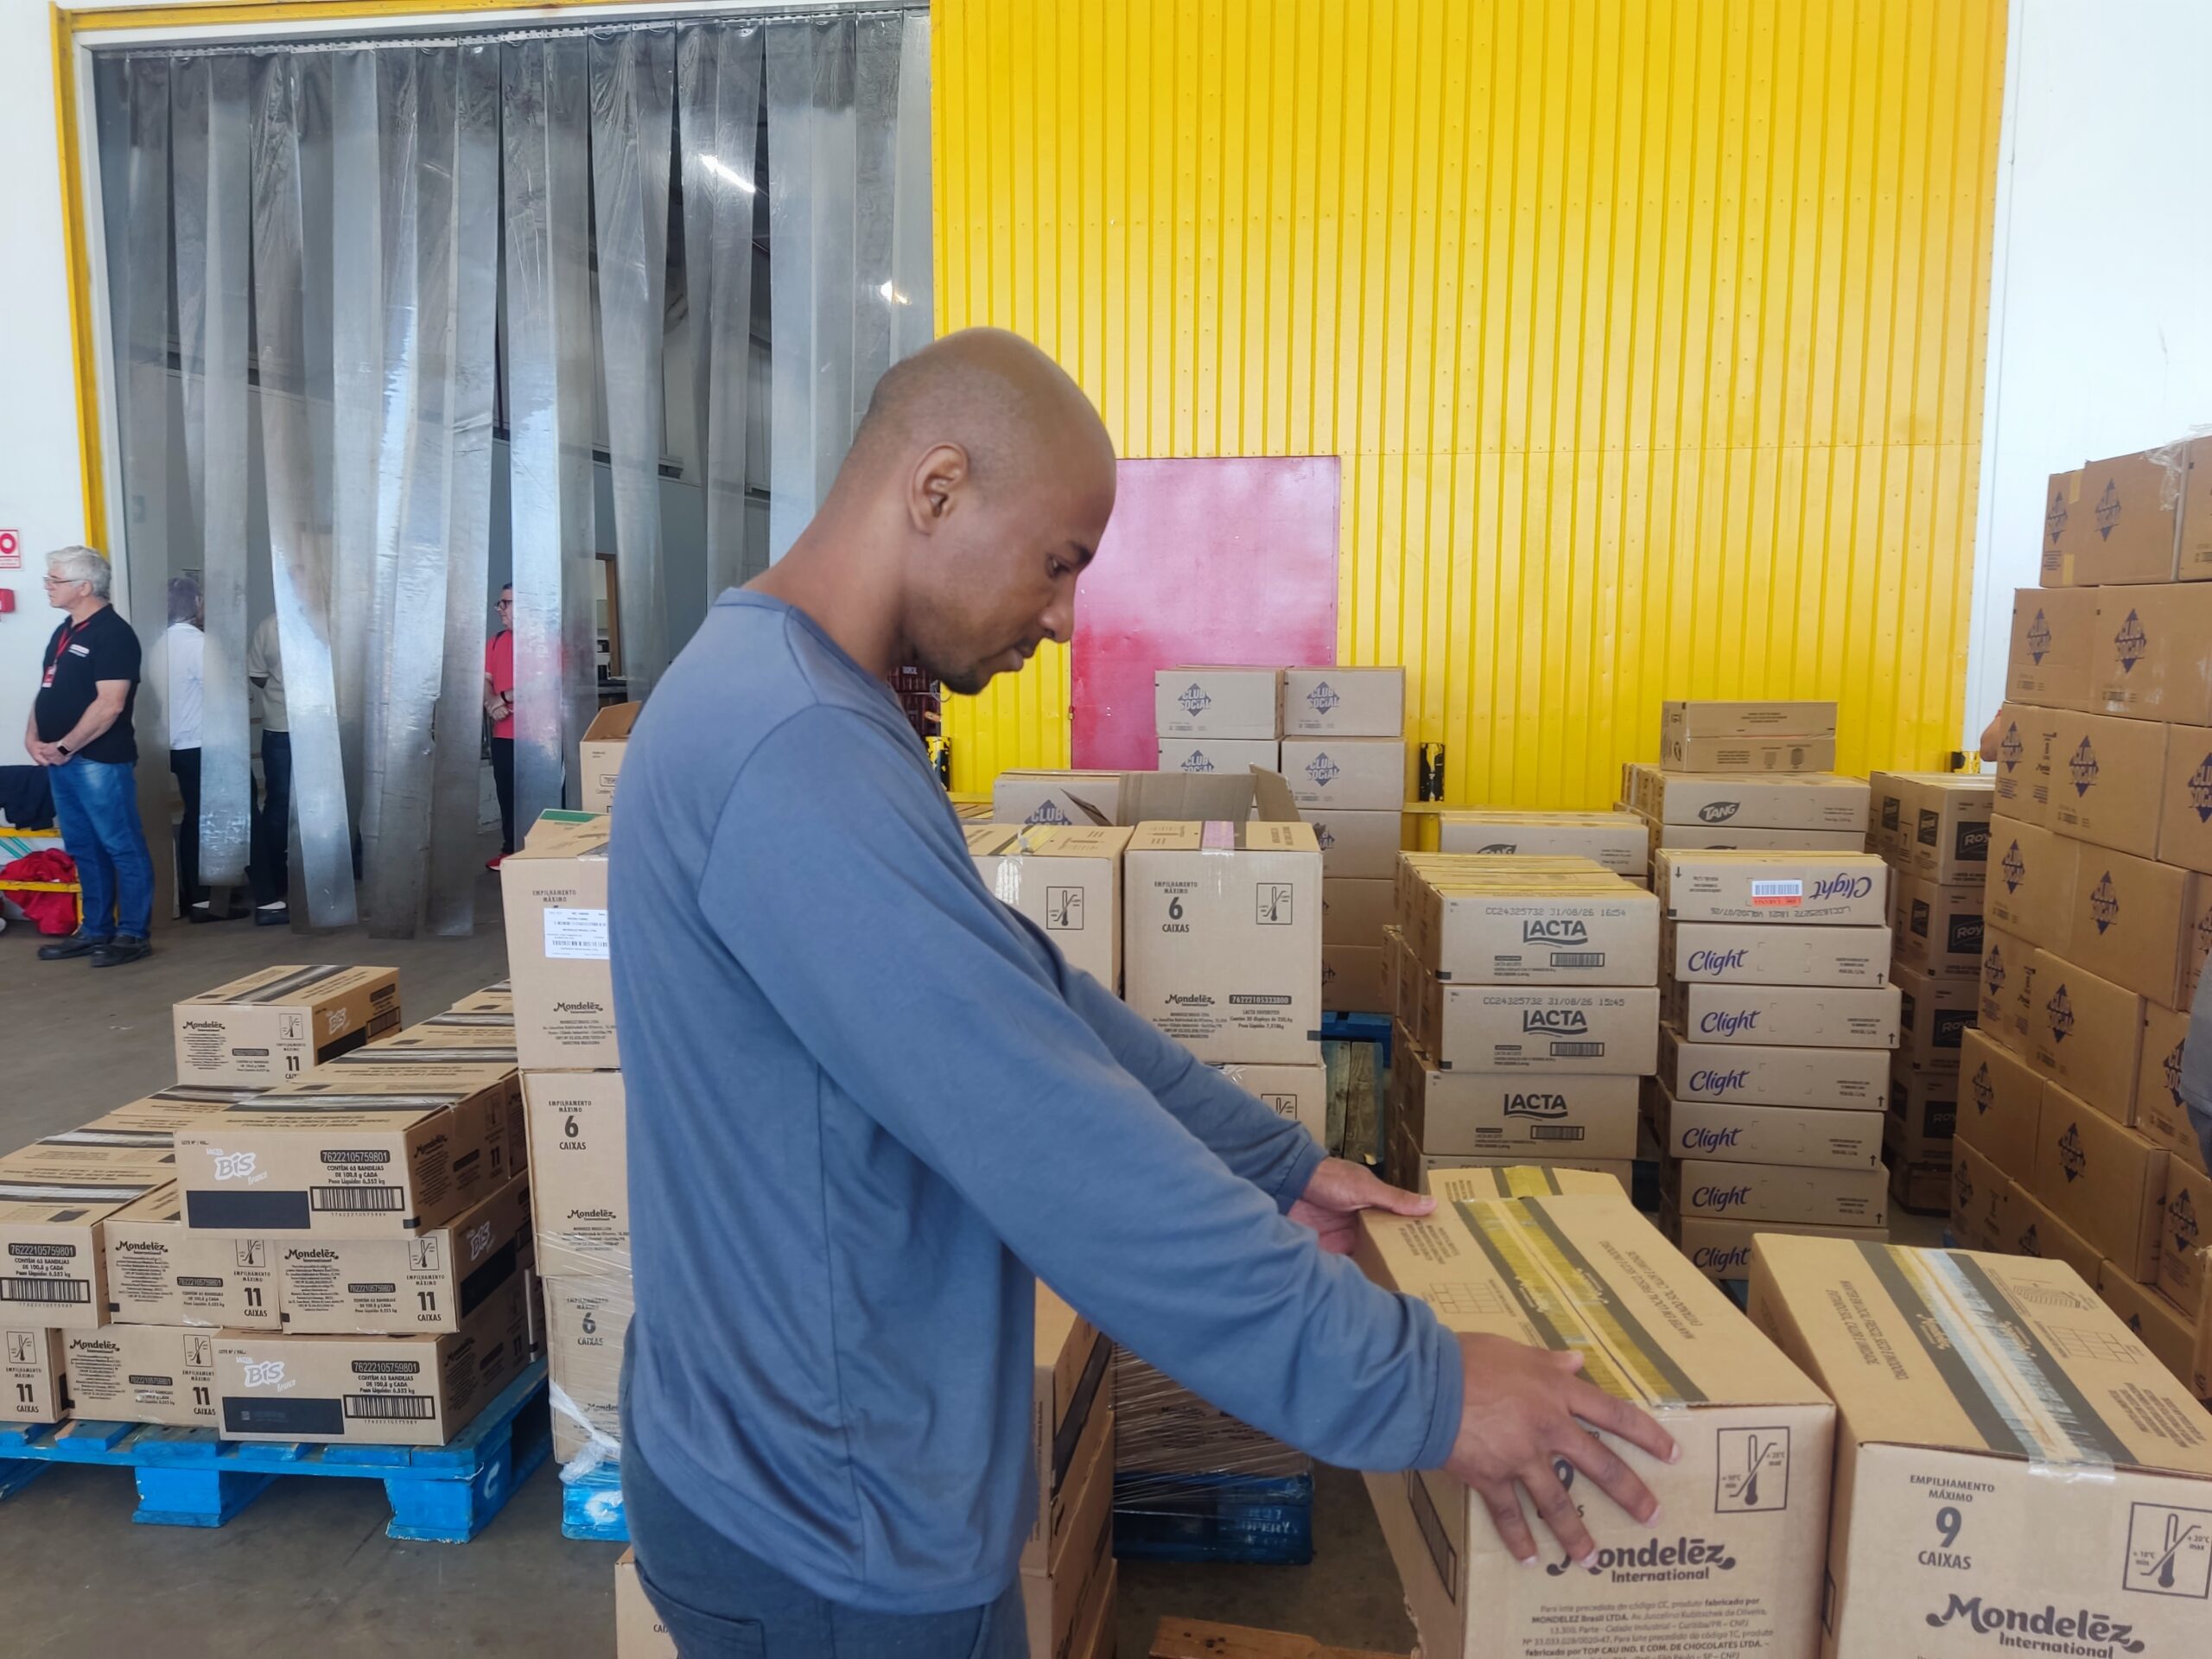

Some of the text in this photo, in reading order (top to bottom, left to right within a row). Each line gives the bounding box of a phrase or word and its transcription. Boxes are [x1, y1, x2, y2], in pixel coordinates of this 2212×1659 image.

[1182, 688, 1205, 699] CLUB
[1311, 687, 1334, 698] CLUB
[1185, 754, 1209, 766] CLUB
[1309, 758, 1333, 769] CLUB
[1031, 808, 1064, 823] CLUB
[1703, 804, 1737, 821] TANG
[1808, 873, 1872, 900] Clight
[1168, 896, 1183, 920] 6
[1162, 924, 1190, 933] CAIXAS
[1523, 920, 1588, 943] LACTA
[1688, 950, 1749, 976] Clight
[554, 1002, 603, 1012] Mondelēz
[1548, 997, 1593, 1007] 31/08/26
[1523, 1009, 1588, 1033] LACTA
[1700, 1009, 1761, 1037] Clight
[286, 1056, 300, 1071] 11
[1689, 1070, 1750, 1096] Clight
[1504, 1093, 1568, 1116] LACTA
[564, 1116, 579, 1138] 6
[559, 1141, 587, 1150] CAIXAS
[1681, 1127, 1743, 1154] Clight
[321, 1151, 388, 1163] 76222105759801
[1692, 1185, 1751, 1211] Clight
[567, 1210, 616, 1219] Mondelēz
[115, 1241, 168, 1253] Mondelēz
[284, 1249, 339, 1260] Mondelēz
[1694, 1246, 1751, 1273] Clight
[245, 1287, 262, 1306] 11
[417, 1292, 435, 1311] 11
[582, 1312, 596, 1334] 6
[354, 1362, 417, 1374] 76222105759801
[16, 1383, 34, 1402] 11
[193, 1387, 210, 1405] 11
[16, 1405, 39, 1414] CAIXAS
[194, 1408, 216, 1416] CAIXAS
[1910, 1474, 1995, 1493] EMPILHAMENTO
[1929, 1489, 1973, 1503] MÁXIMO
[1936, 1506, 1961, 1548] 9
[1917, 1550, 1972, 1570] CAIXAS
[1611, 1567, 1709, 1583] International
[1705, 1598, 1744, 1607] fabricado
[1745, 1598, 1759, 1606] por
[1729, 1618, 1749, 1627] CNPJ
[1926, 1593, 2145, 1654] Mondelēz
[1742, 1629, 1774, 1638] produto
[1646, 1643, 1669, 1652] COM.
[1669, 1642, 1681, 1650] DE
[1683, 1640, 1738, 1650] CHOCOLATES
[1739, 1639, 1763, 1649] LTDA.
[1999, 1631, 2113, 1659] International
